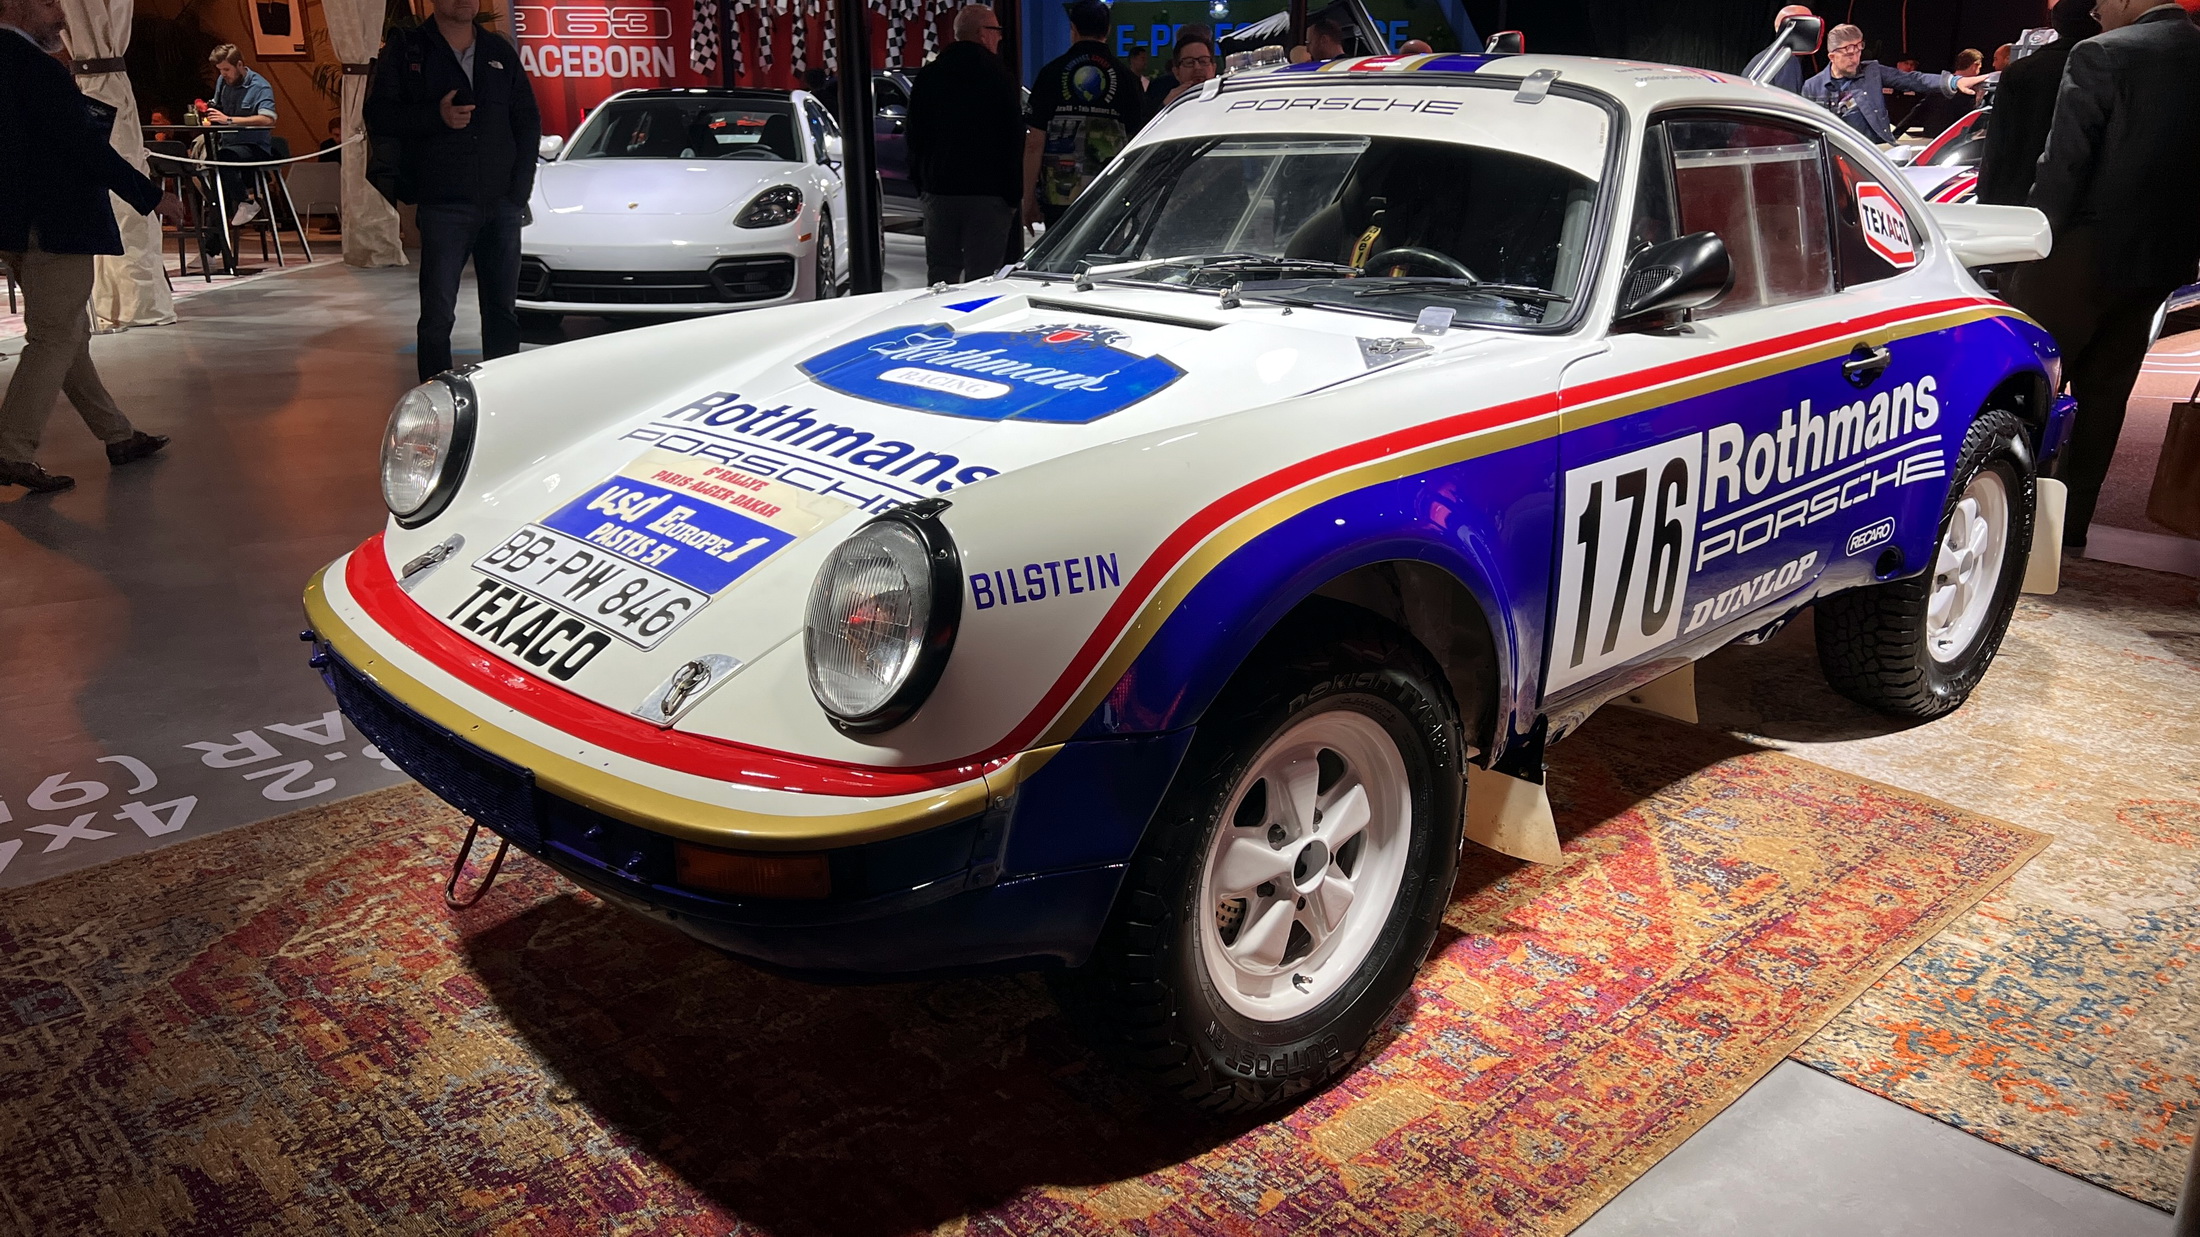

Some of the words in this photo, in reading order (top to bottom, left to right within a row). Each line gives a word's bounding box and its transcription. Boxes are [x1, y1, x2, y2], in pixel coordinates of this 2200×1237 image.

[519, 45, 676, 78] ACEBORN
[1226, 98, 1463, 115] PORSCHE
[1862, 204, 1909, 246] TEXACO
[868, 333, 1120, 391] Rothmans
[897, 370, 988, 393] RACING
[662, 391, 1001, 493] Rothmans
[1703, 375, 1939, 512] Rothmans
[651, 470, 781, 518] PARIS-ALGER-DAKAR
[1696, 449, 1945, 571] PORSCHE
[585, 522, 660, 558] PASTIS
[640, 541, 678, 567] 51
[719, 537, 770, 563] 1
[1569, 457, 1688, 669] 176
[1850, 523, 1890, 550] RECARO
[598, 578, 692, 636] 846
[969, 553, 1120, 610] BILSTEIN
[1683, 551, 1818, 634] DUNLOP
[447, 578, 612, 681] TEXACO
[182, 709, 347, 769] AR
[0, 795, 199, 874] 4x
[1225, 1033, 1339, 1078] OUTPOST
